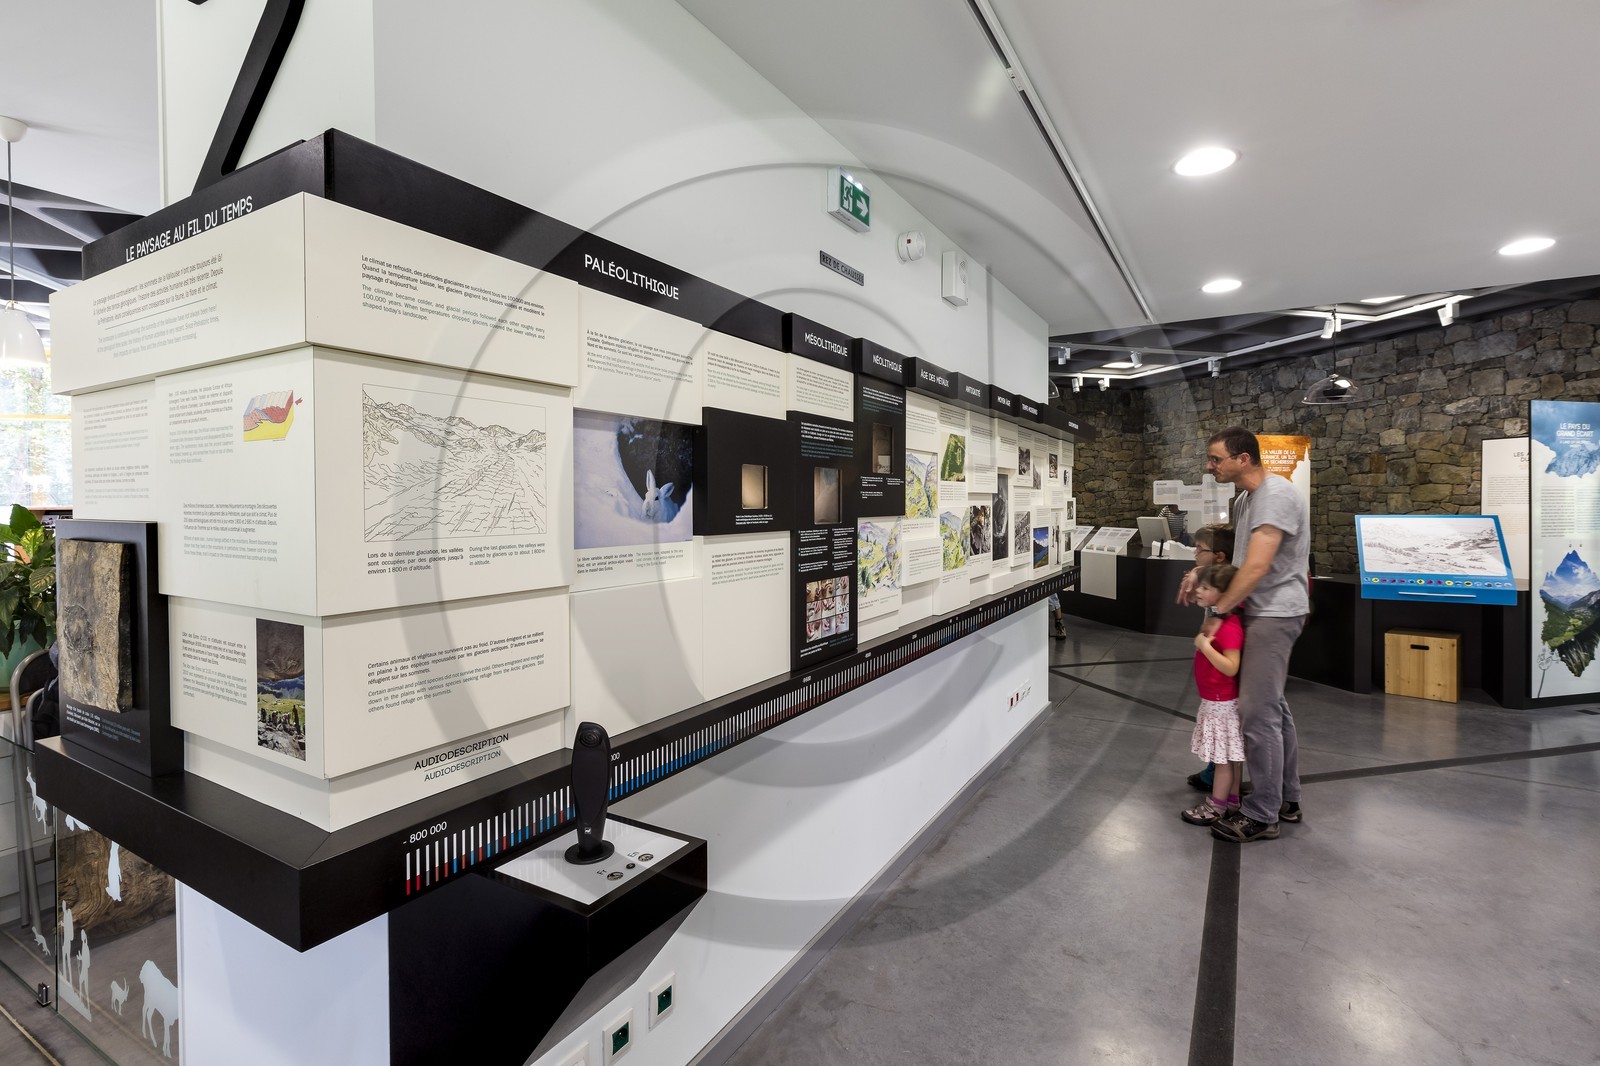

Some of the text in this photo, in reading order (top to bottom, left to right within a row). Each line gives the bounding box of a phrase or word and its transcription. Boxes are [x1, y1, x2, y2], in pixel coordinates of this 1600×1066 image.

[126, 195, 253, 262] LE PAYSAGE AU FIL DU TEMPS
[362, 273, 383, 283] paysage
[362, 263, 379, 273] Quand
[388, 271, 418, 283] température
[446, 287, 463, 295] glaciers
[367, 258, 385, 266] climat
[422, 273, 443, 282] périodes
[444, 279, 464, 288] glaciaires
[584, 253, 679, 301] PALÉOLITHIQUE
[362, 284, 371, 292] The
[374, 288, 393, 297] climate
[396, 292, 415, 302] became
[362, 302, 428, 320] shaped today's landscape.
[363, 293, 386, 303] 100,000
[404, 302, 418, 310] When
[420, 307, 450, 318] temperatures
[804, 332, 848, 358] MÉSOLITHIQUE
[872, 354, 903, 374] NÉOLITHIQUE
[920, 368, 950, 388] ÂGE DES MÉTAUX
[1559, 422, 1567, 430] LE
[429, 555, 446, 563] glaciers
[368, 661, 389, 669] Certains
[390, 657, 410, 665] animaux
[377, 668, 392, 676] plaine
[431, 655, 456, 664] repoussées
[368, 676, 390, 685] réfugient
[368, 689, 386, 697] Certain
[386, 684, 404, 693] animal
[426, 676, 444, 684] species
[401, 690, 415, 698] plains
[428, 683, 444, 691] various
[445, 679, 461, 687] species
[368, 705, 384, 713] others
[385, 701, 400, 709] found
[414, 733, 509, 771] AUDIODESCRIPTION
[424, 750, 502, 782] AUDIODESCRIPTION
[409, 828, 428, 844] 800
[429, 820, 448, 837] 000
